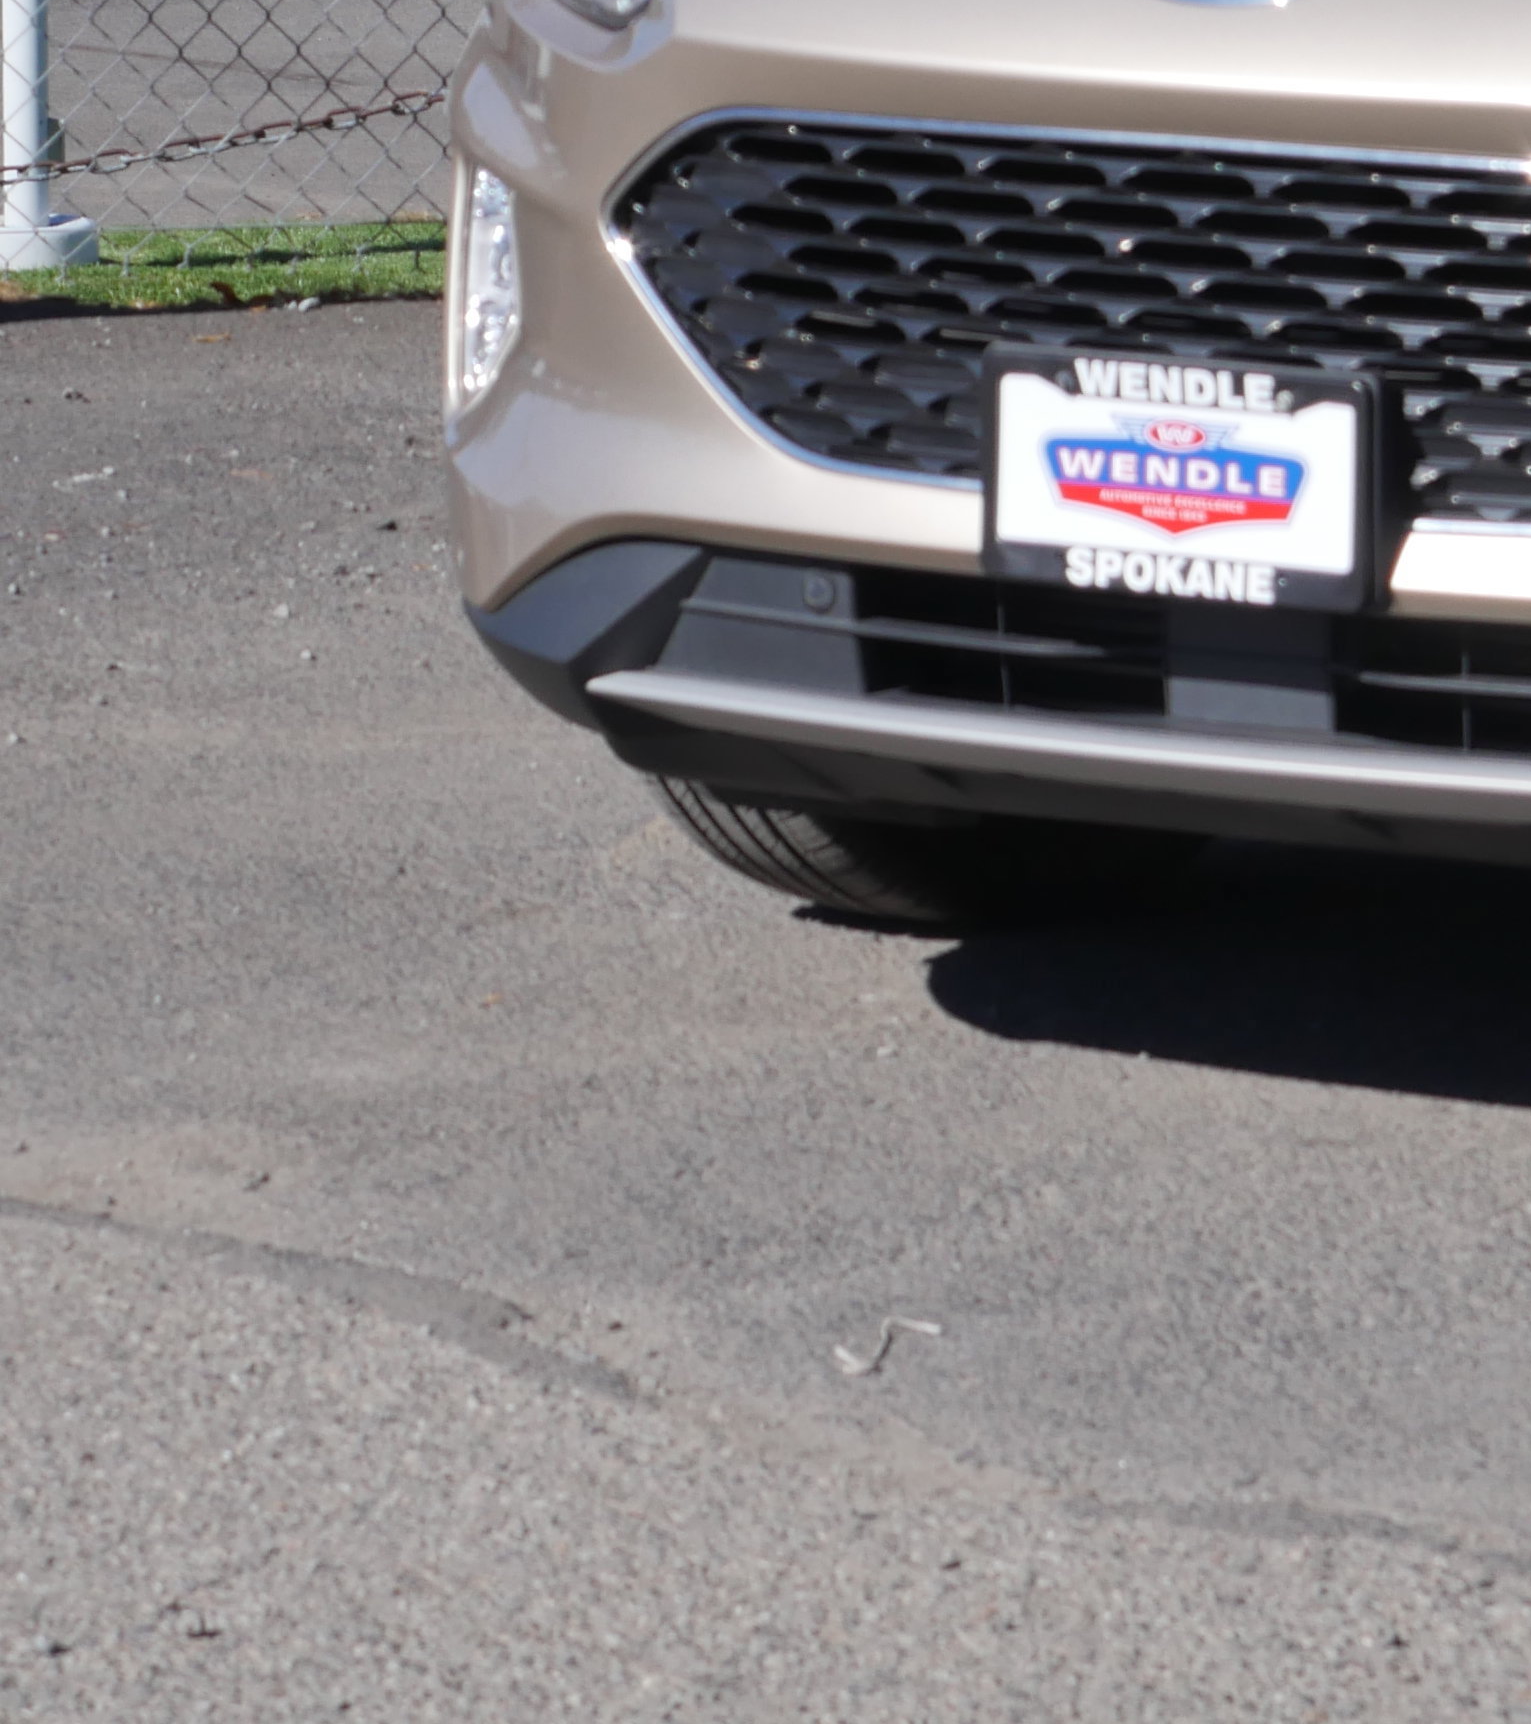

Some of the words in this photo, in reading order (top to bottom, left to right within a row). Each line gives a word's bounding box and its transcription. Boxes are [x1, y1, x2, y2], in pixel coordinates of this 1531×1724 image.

[1073, 357, 1276, 411] WENDLE
[1057, 447, 1287, 498] WENDLE
[1065, 545, 1276, 606] SPOKANE
